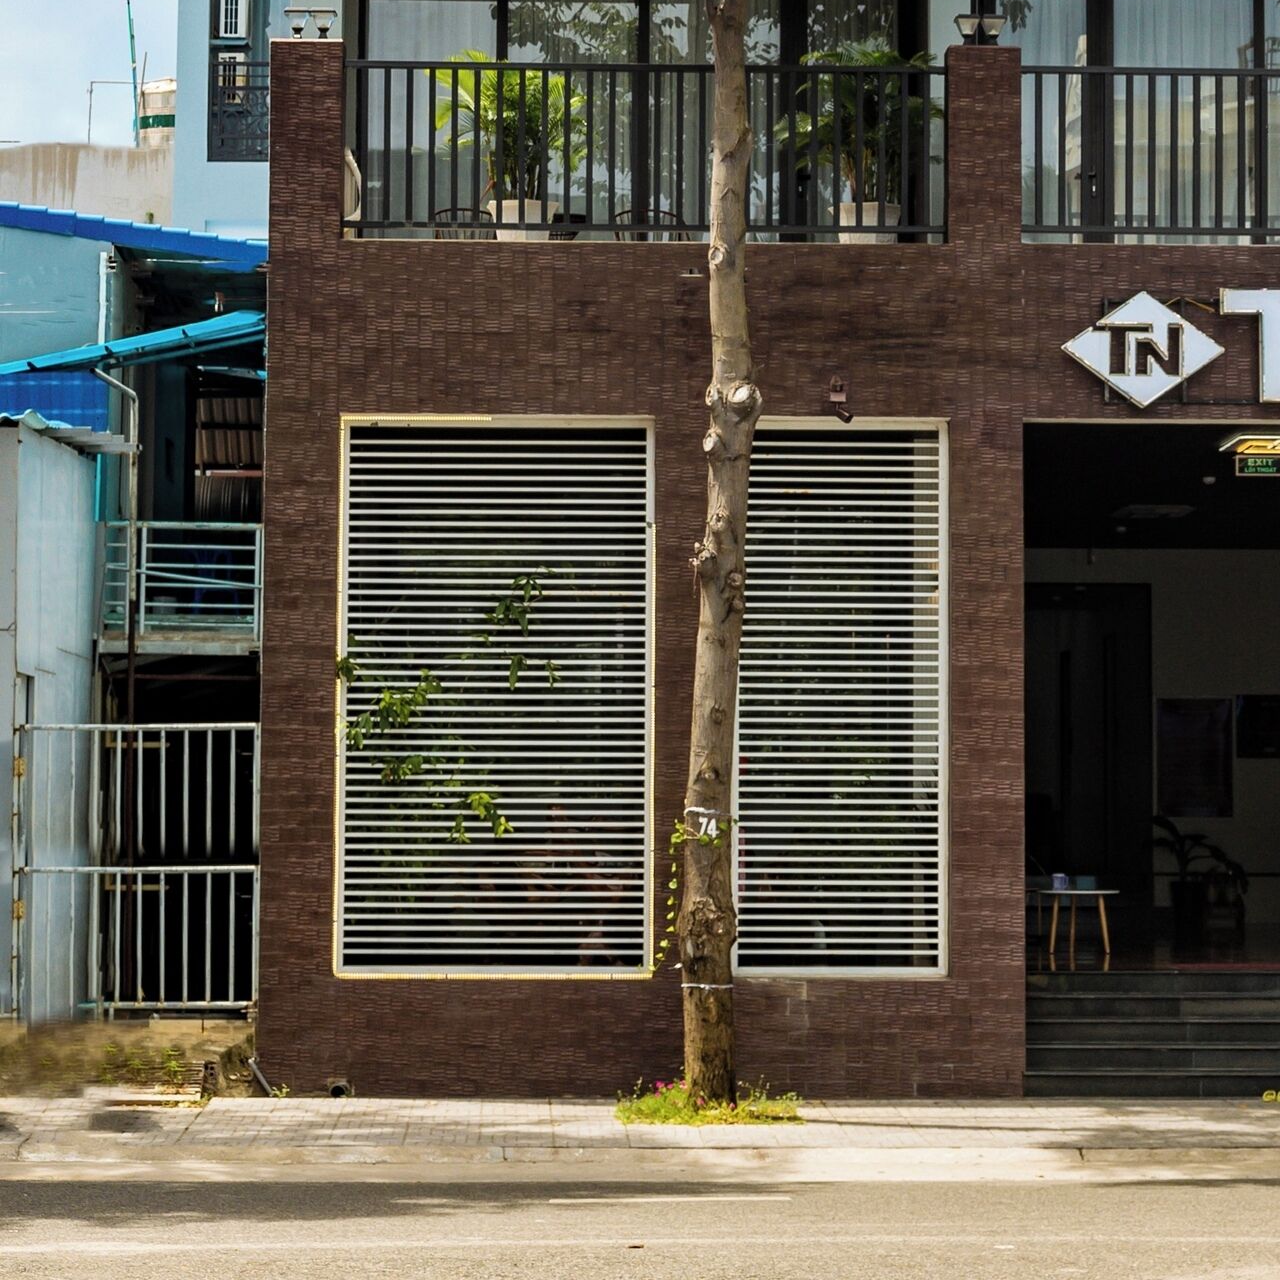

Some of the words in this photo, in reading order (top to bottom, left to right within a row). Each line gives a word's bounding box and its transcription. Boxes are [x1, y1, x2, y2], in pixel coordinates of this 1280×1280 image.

[1094, 321, 1184, 377] TN
[1247, 458, 1273, 466] EXIT
[698, 816, 720, 839] 74
